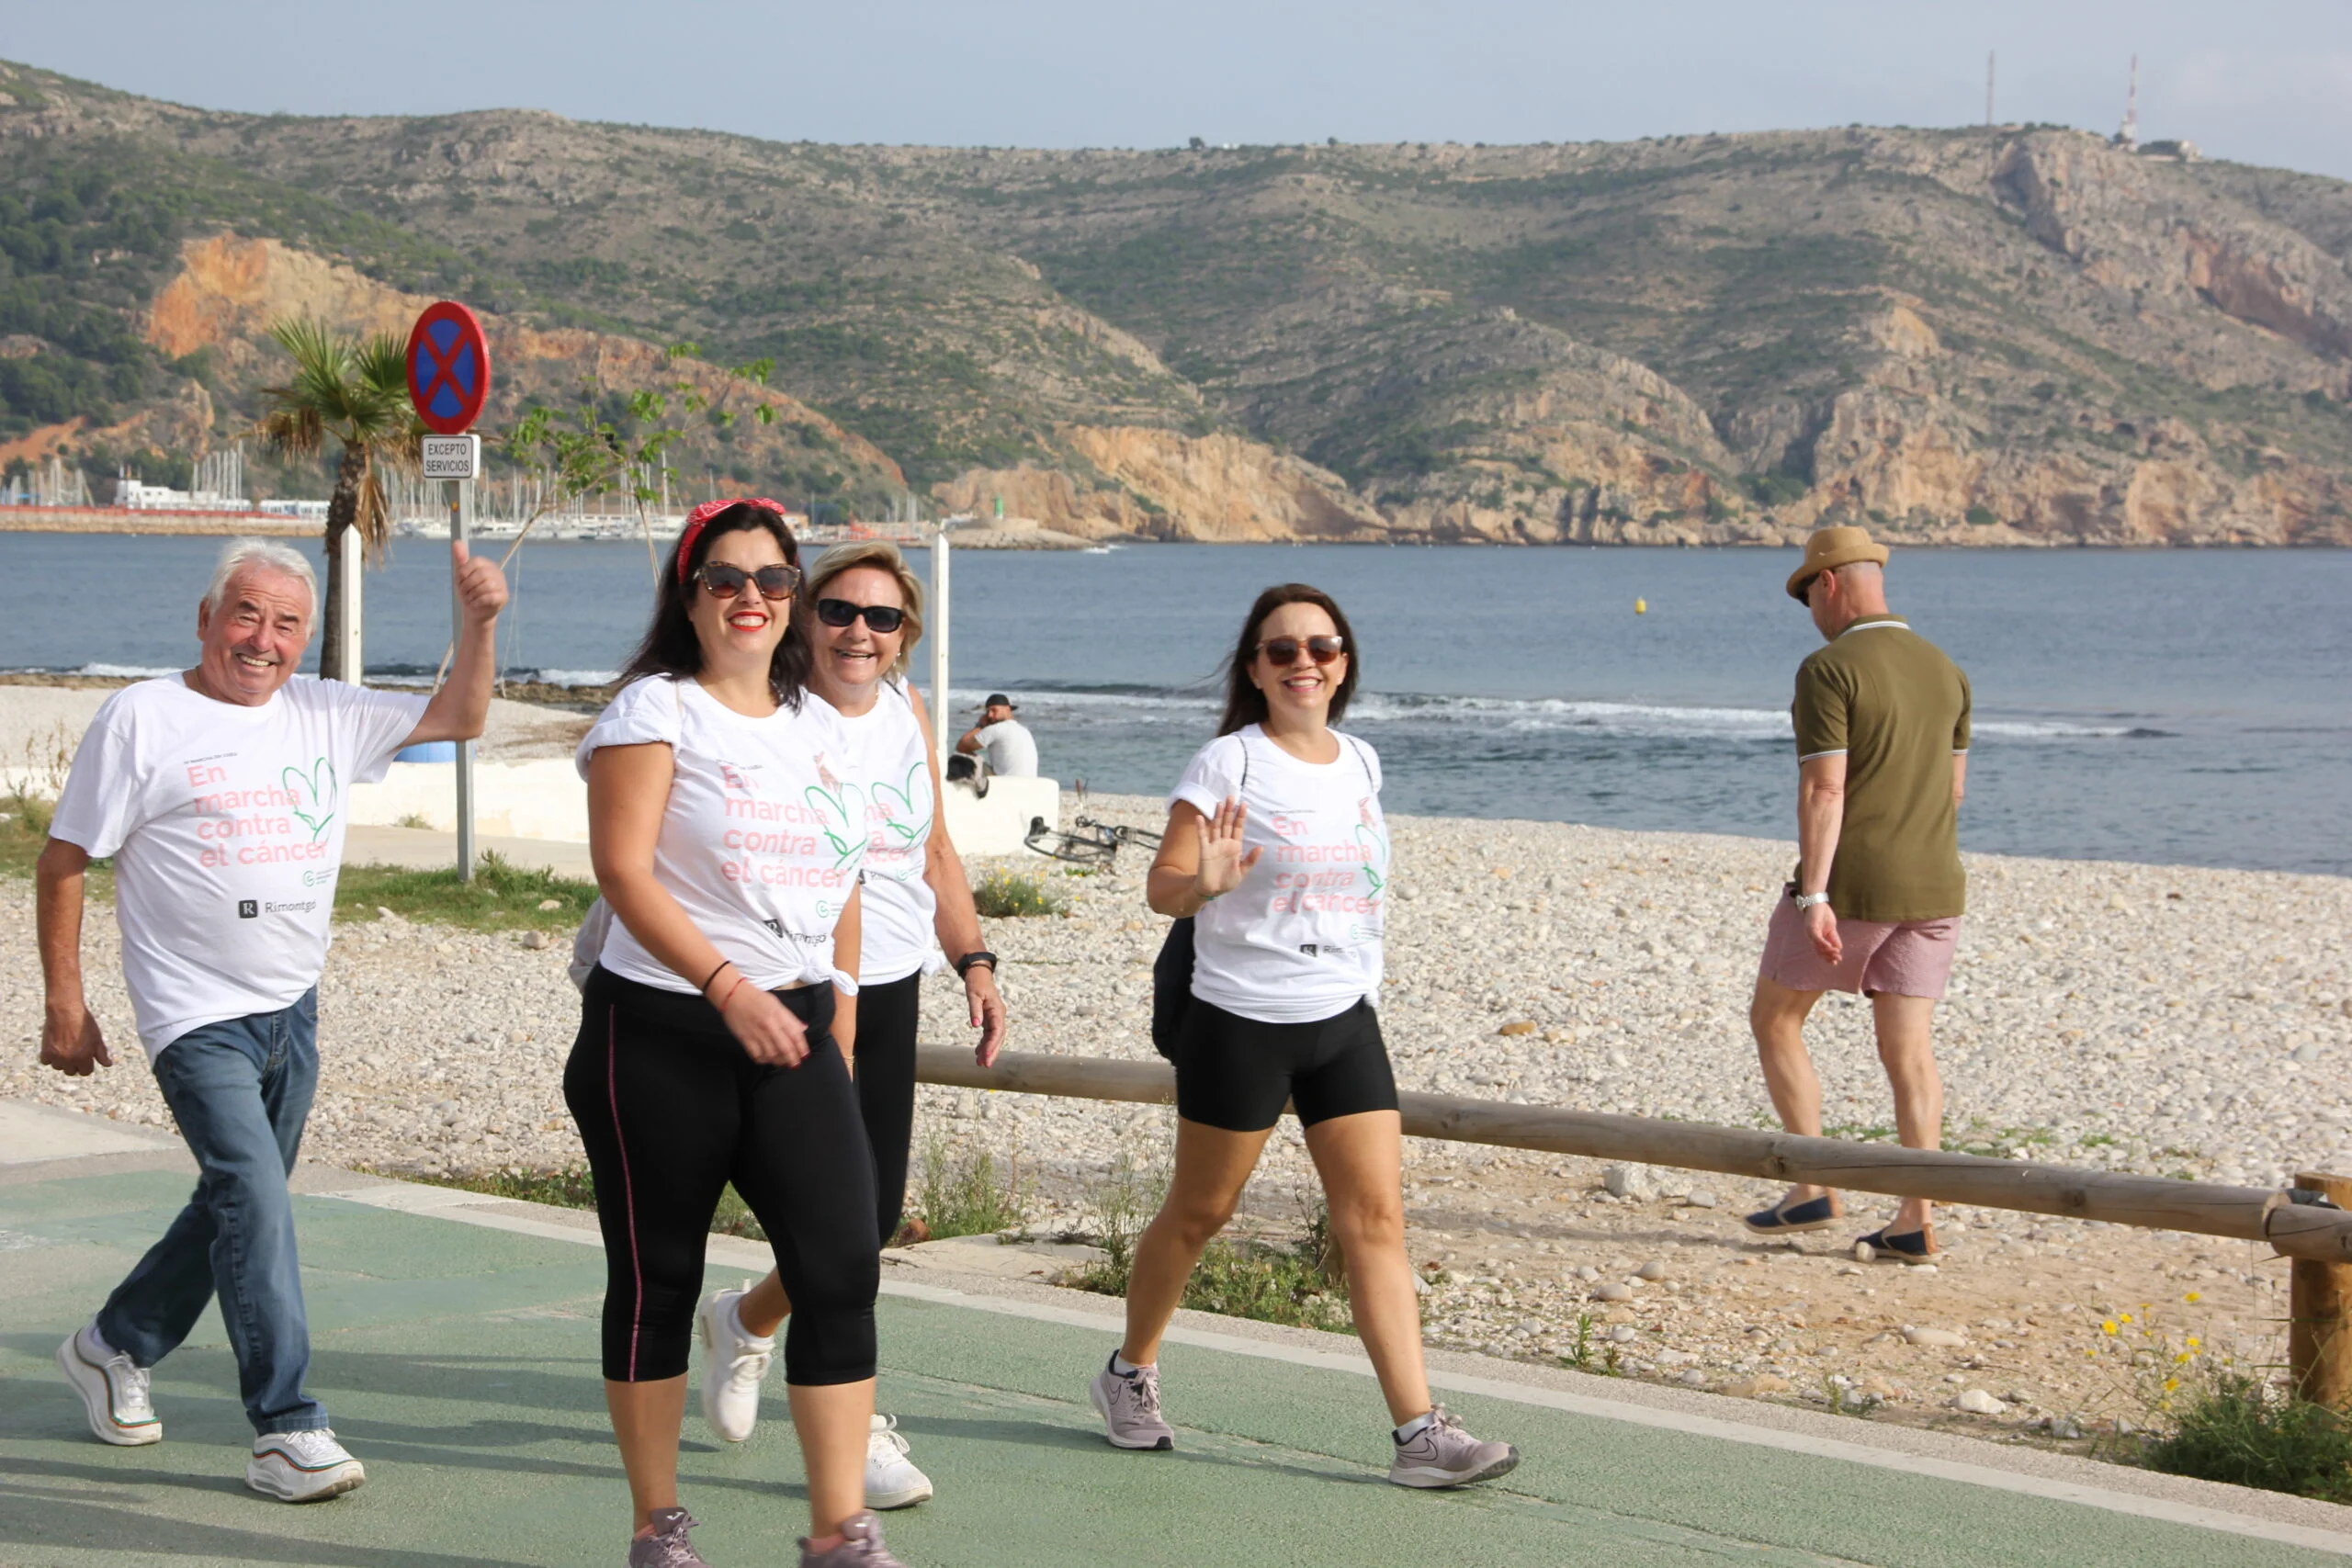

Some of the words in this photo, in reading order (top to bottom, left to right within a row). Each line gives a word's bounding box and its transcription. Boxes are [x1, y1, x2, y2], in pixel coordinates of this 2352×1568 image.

[428, 443, 467, 455] EXCEPTO
[425, 460, 469, 472] SERVICIOS
[187, 764, 227, 788] En
[195, 784, 302, 814] marcha
[724, 797, 831, 826] marcha
[197, 813, 291, 840] contra
[1272, 816, 1309, 837] En
[198, 843, 230, 868] el
[237, 840, 329, 865] cáncer
[723, 829, 817, 855] contra
[1276, 840, 1373, 863] marcha
[720, 856, 752, 885] el
[759, 859, 849, 888] cáncer
[1273, 867, 1356, 889] contra
[1273, 890, 1298, 915] el
